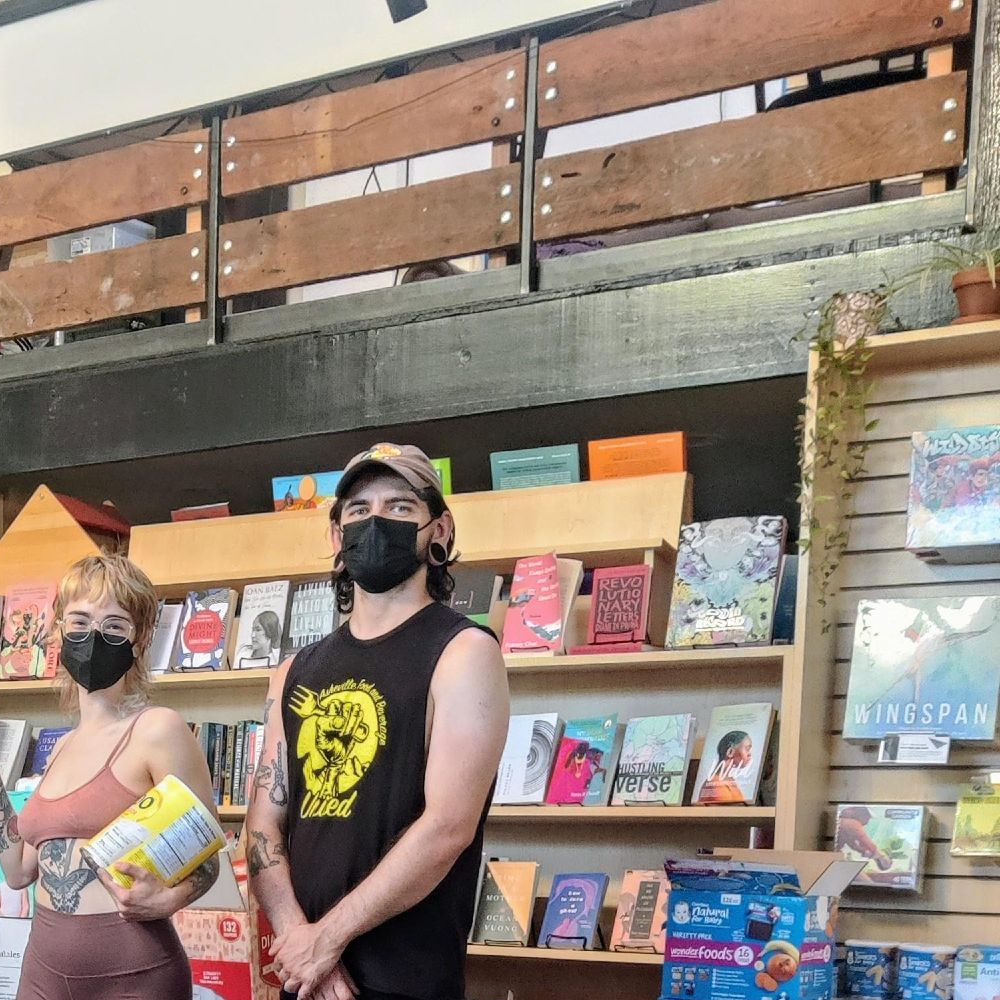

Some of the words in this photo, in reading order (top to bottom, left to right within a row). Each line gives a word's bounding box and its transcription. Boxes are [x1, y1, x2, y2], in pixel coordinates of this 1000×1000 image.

[600, 577, 642, 590] REVO
[599, 589, 641, 602] LUTIO
[599, 599, 640, 612] NARY
[597, 611, 639, 622] LETTERS
[189, 622, 216, 630] DIVINE
[189, 631, 216, 639] MIGHT
[855, 702, 988, 724] WINGSPAN
[619, 762, 666, 773] HUSTLING
[616, 775, 671, 793] verse
[692, 907, 729, 919] Natural
[223, 921, 237, 933] 132
[739, 949, 749, 957] 16
